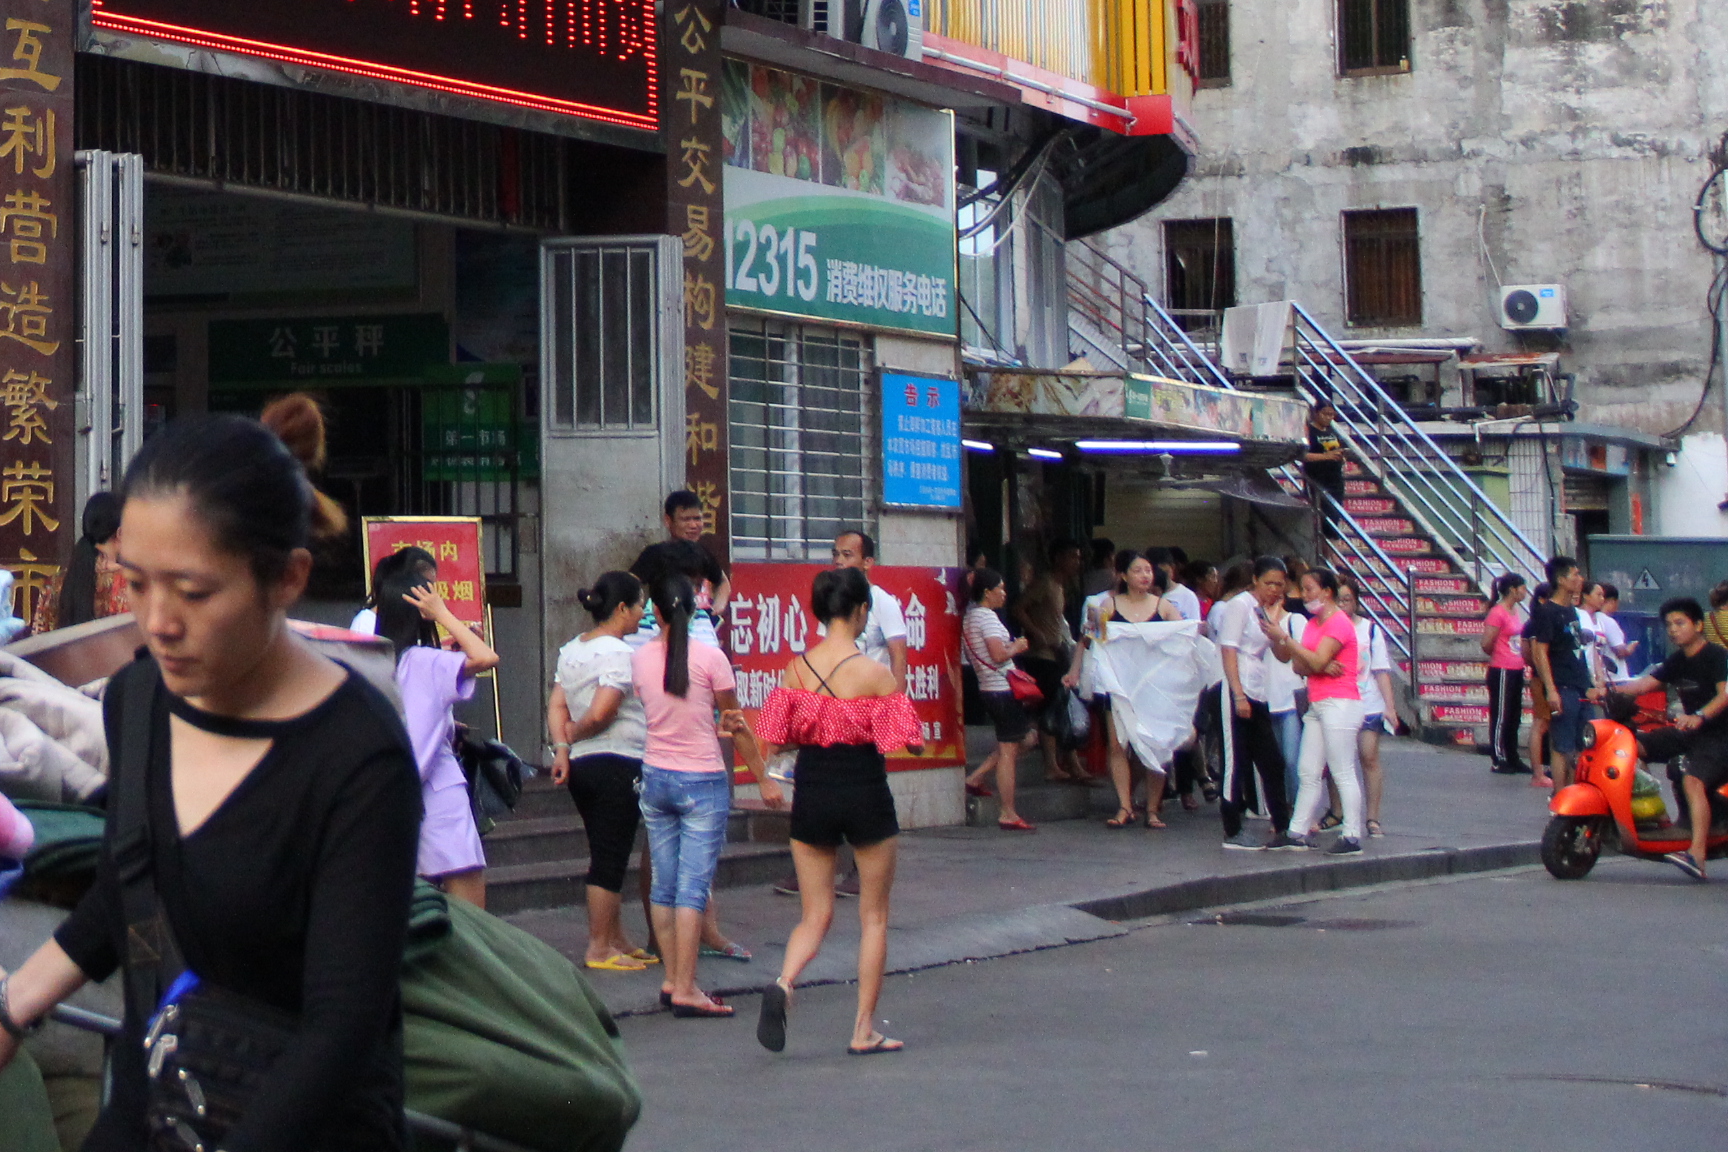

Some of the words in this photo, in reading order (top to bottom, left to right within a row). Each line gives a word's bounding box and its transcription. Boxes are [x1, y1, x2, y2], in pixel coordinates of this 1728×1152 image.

[723, 218, 818, 302] 12315
[826, 258, 947, 318] 消费维权服务电话
[904, 383, 940, 408] 告示
